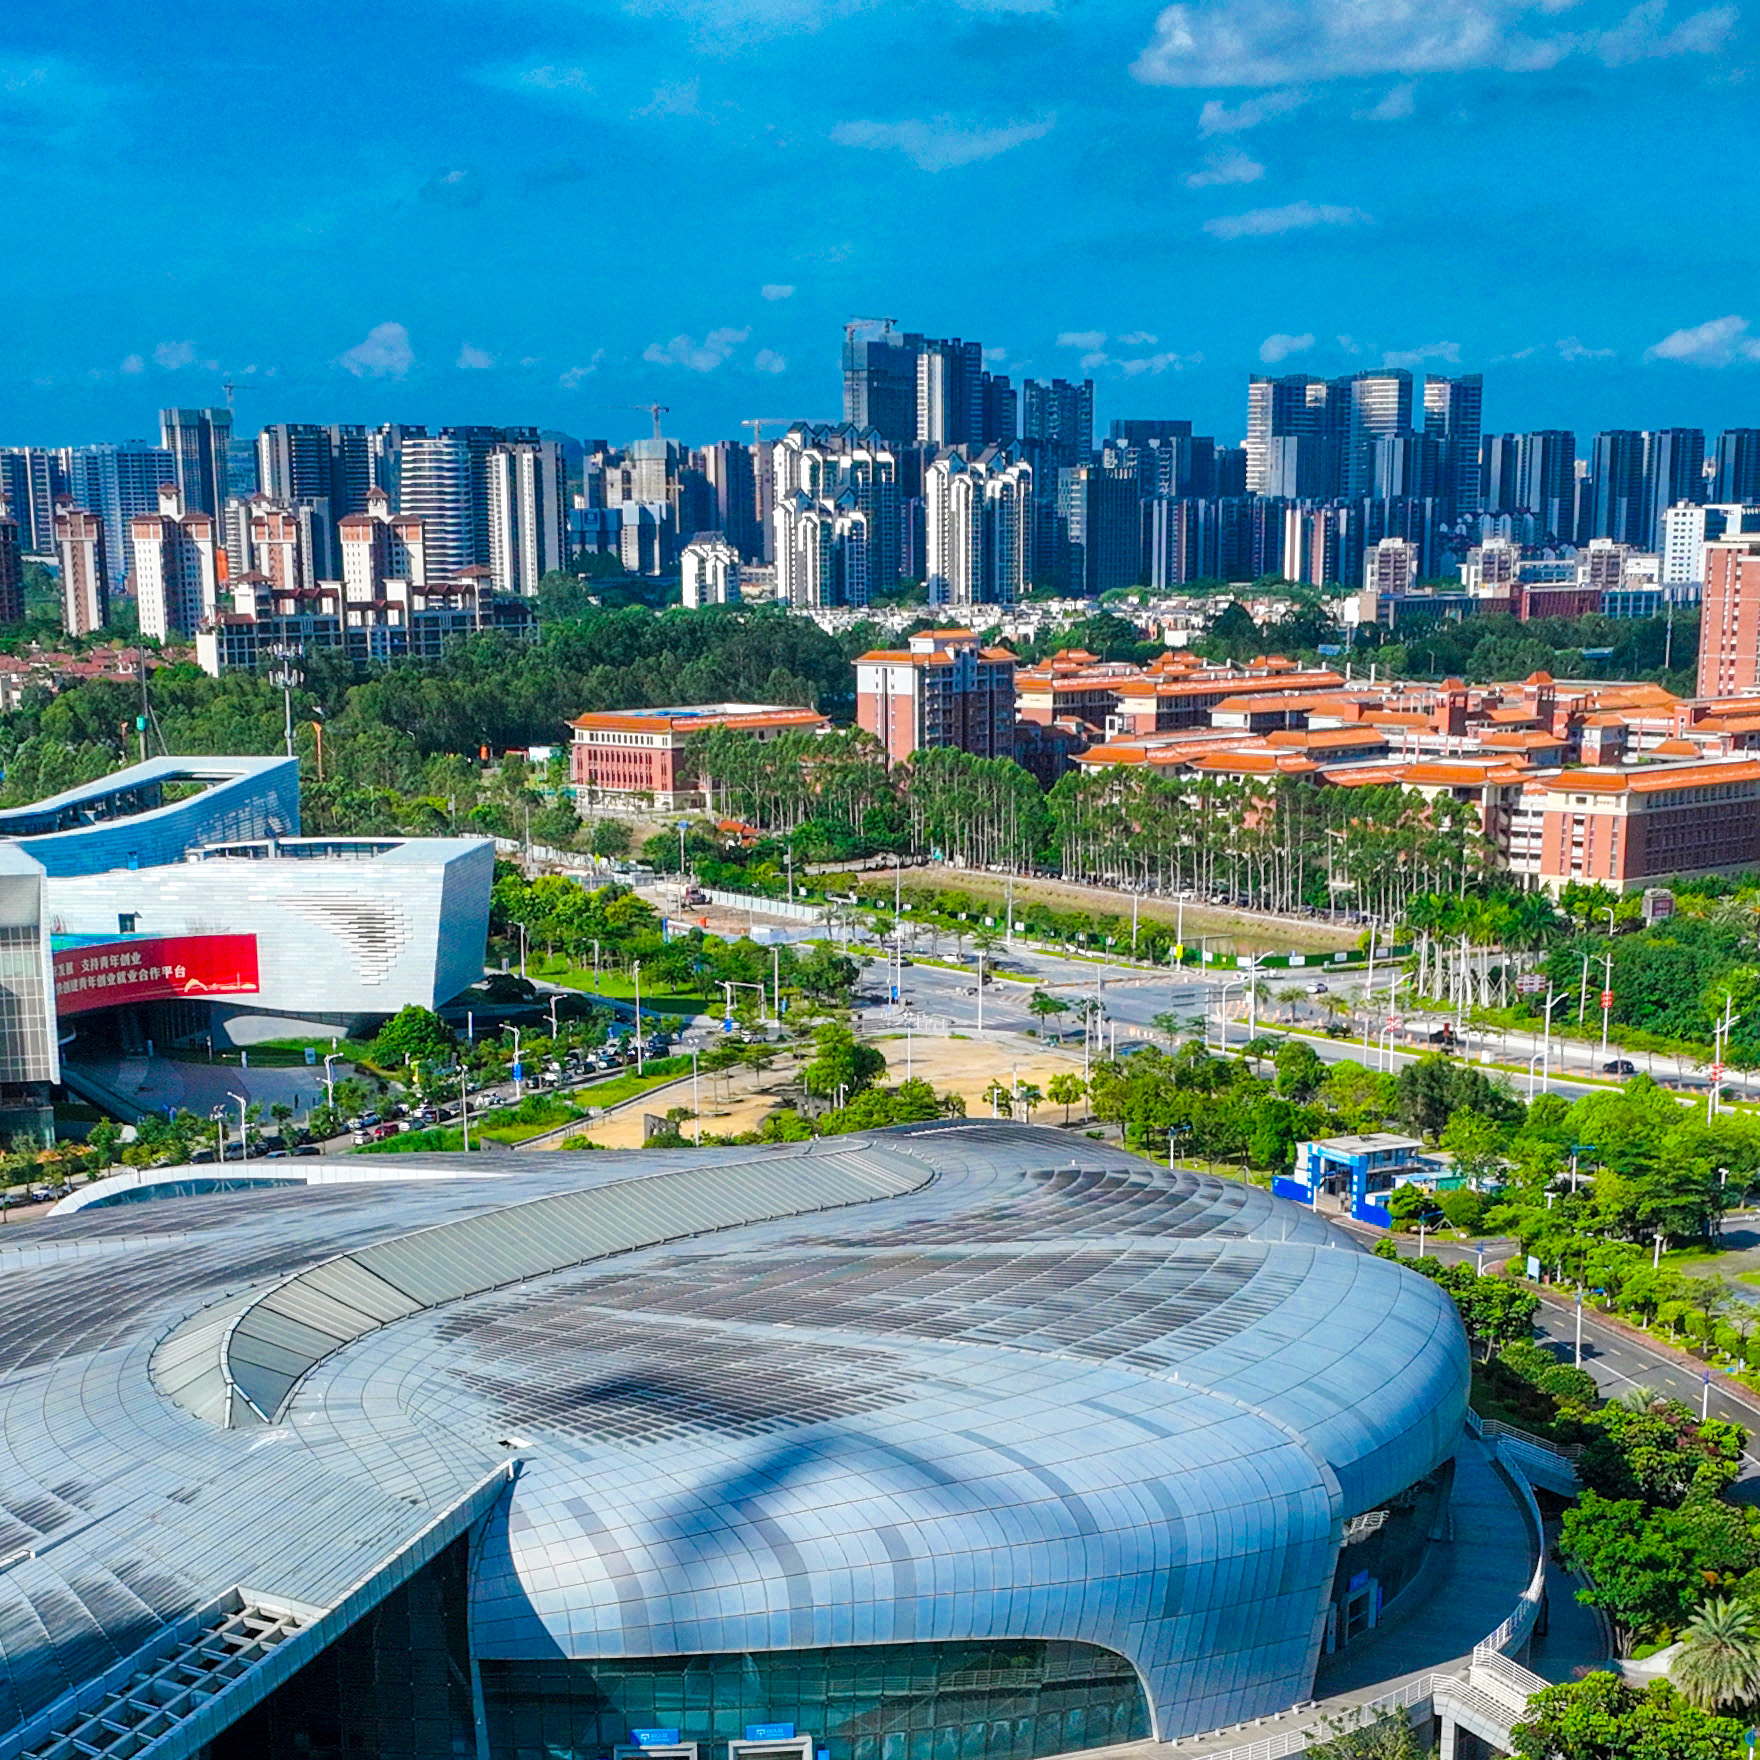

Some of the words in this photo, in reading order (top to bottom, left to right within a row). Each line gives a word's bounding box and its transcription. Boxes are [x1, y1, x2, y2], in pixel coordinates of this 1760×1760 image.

[81, 952, 142, 973] 支持青年创业
